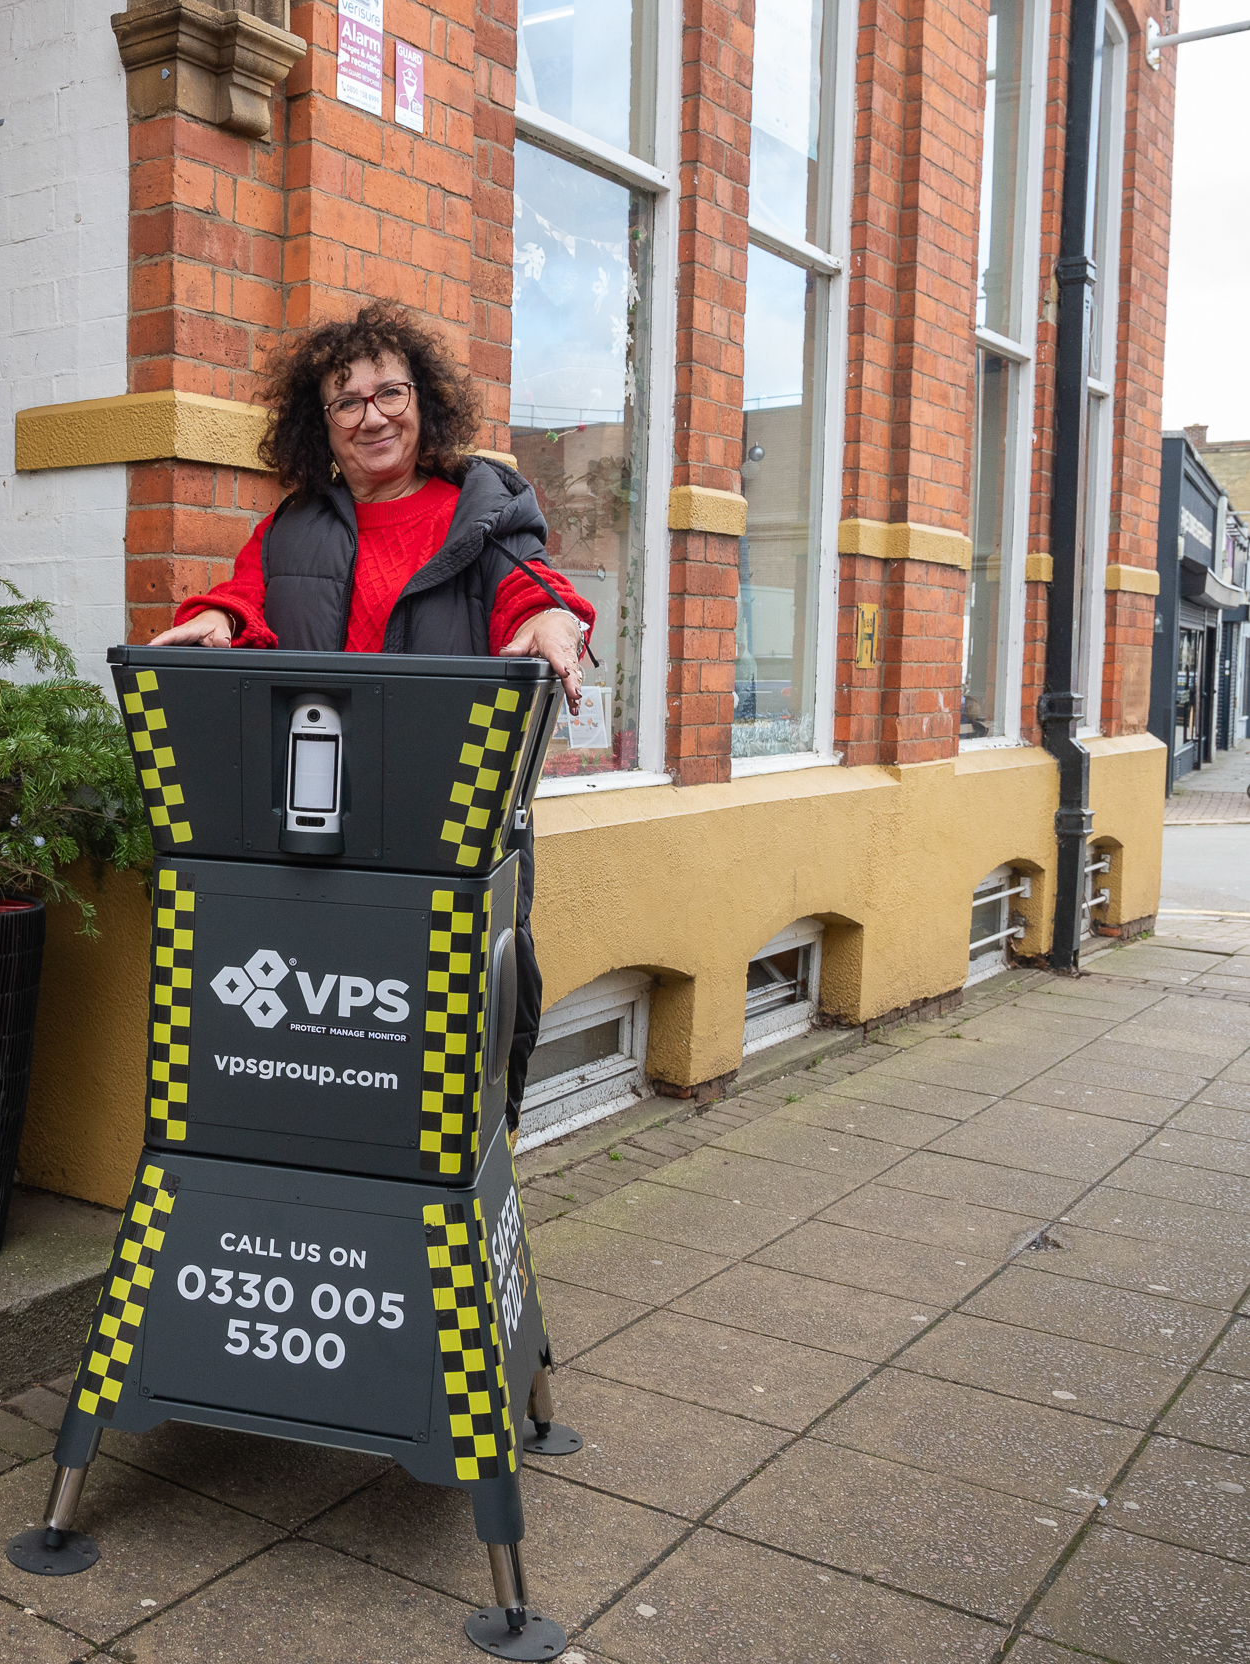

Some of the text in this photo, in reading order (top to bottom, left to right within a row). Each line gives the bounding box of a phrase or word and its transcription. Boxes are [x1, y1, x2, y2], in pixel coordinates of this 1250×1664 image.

[342, 0, 380, 26] verisure
[340, 40, 380, 64] Images & Audio
[341, 20, 380, 54] Alarm
[351, 56, 380, 78] recording
[397, 45, 422, 65] GUARD
[295, 971, 410, 1023] VPS
[290, 1023, 407, 1042] PROTECT MANAGE MONITOR
[214, 1054, 398, 1090] vpsgroup.com
[220, 1232, 366, 1269] CALL US ON
[492, 1185, 521, 1290] SAFER
[177, 1264, 405, 1330] 0330 005
[224, 1318, 346, 1369] 5300
